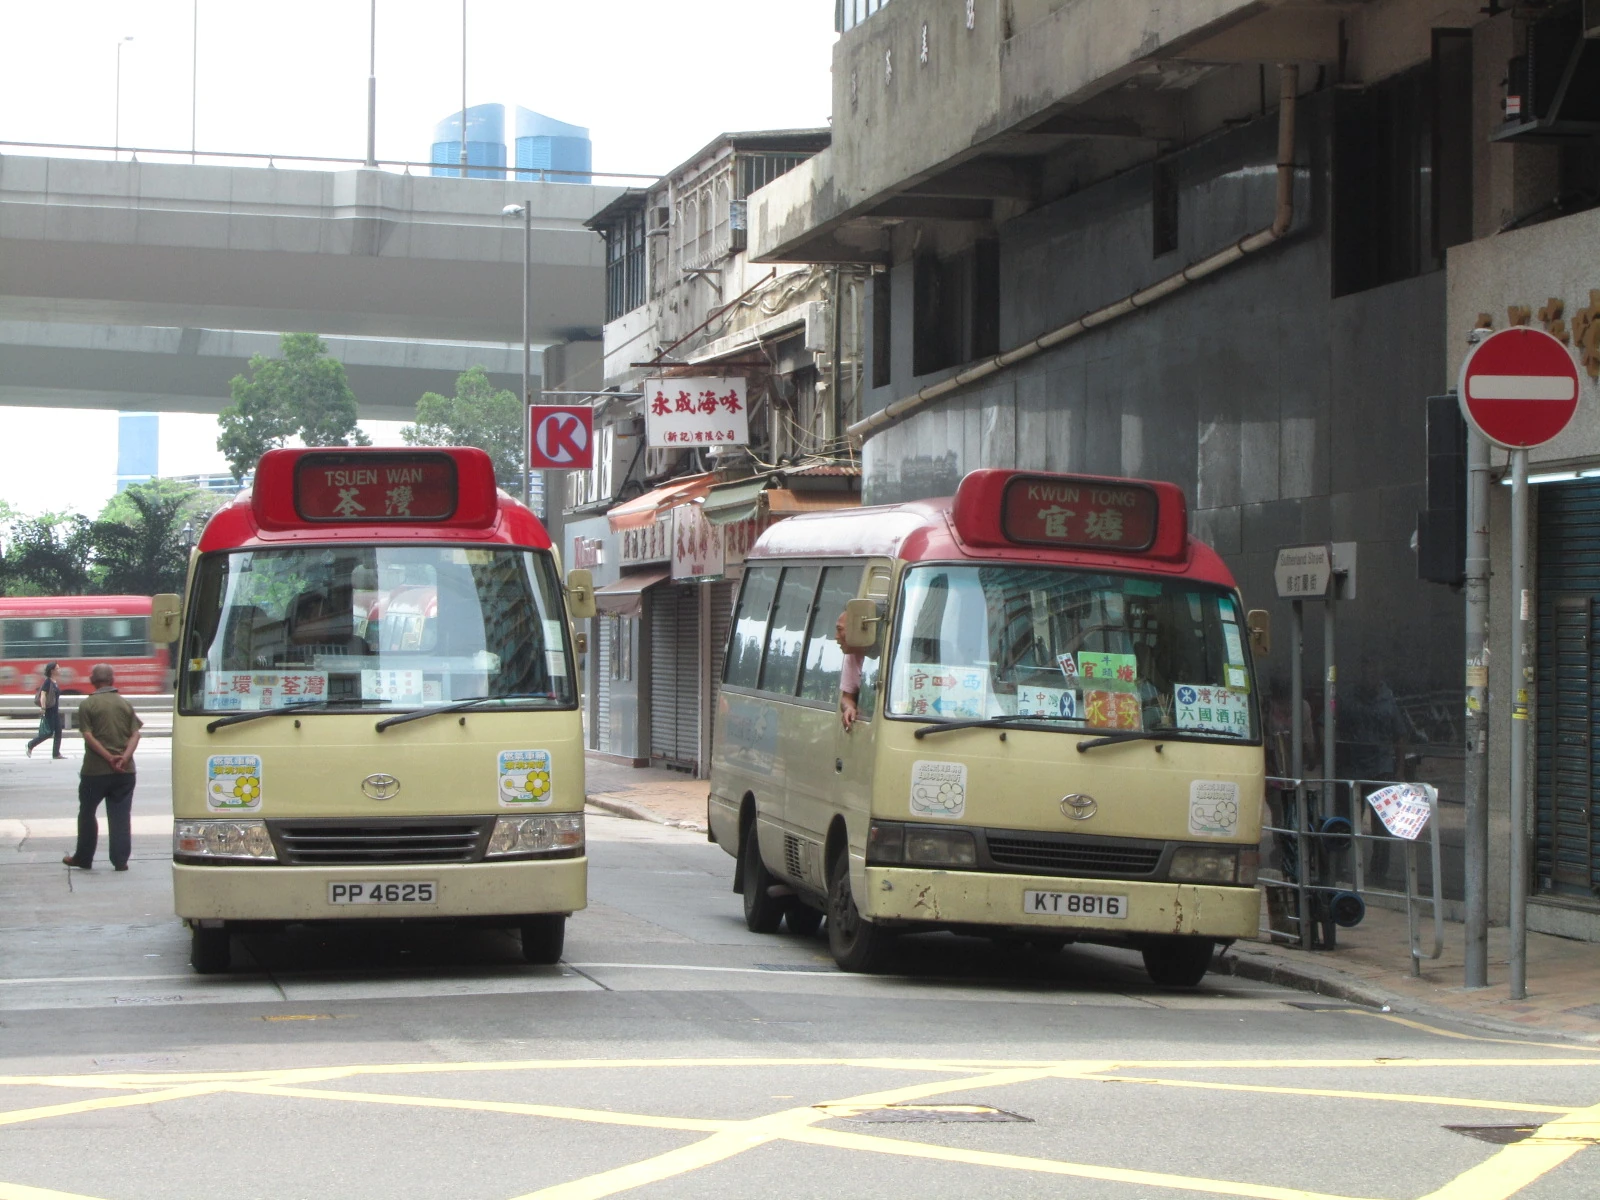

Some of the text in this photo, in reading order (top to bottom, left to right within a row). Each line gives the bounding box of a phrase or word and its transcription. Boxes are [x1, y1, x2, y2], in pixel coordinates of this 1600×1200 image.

[546, 415, 584, 460] K
[325, 468, 423, 486] TSUEN WAN
[1028, 485, 1136, 507] KWUN TONG
[1037, 505, 1124, 541] 官塘
[1060, 657, 1076, 675] 15
[280, 675, 326, 696] 荃灣
[1197, 687, 1231, 706] 灣仔
[1180, 706, 1246, 726] 六國酒店
[333, 884, 432, 902] PP 4625
[1035, 892, 1120, 915] KT 8816
